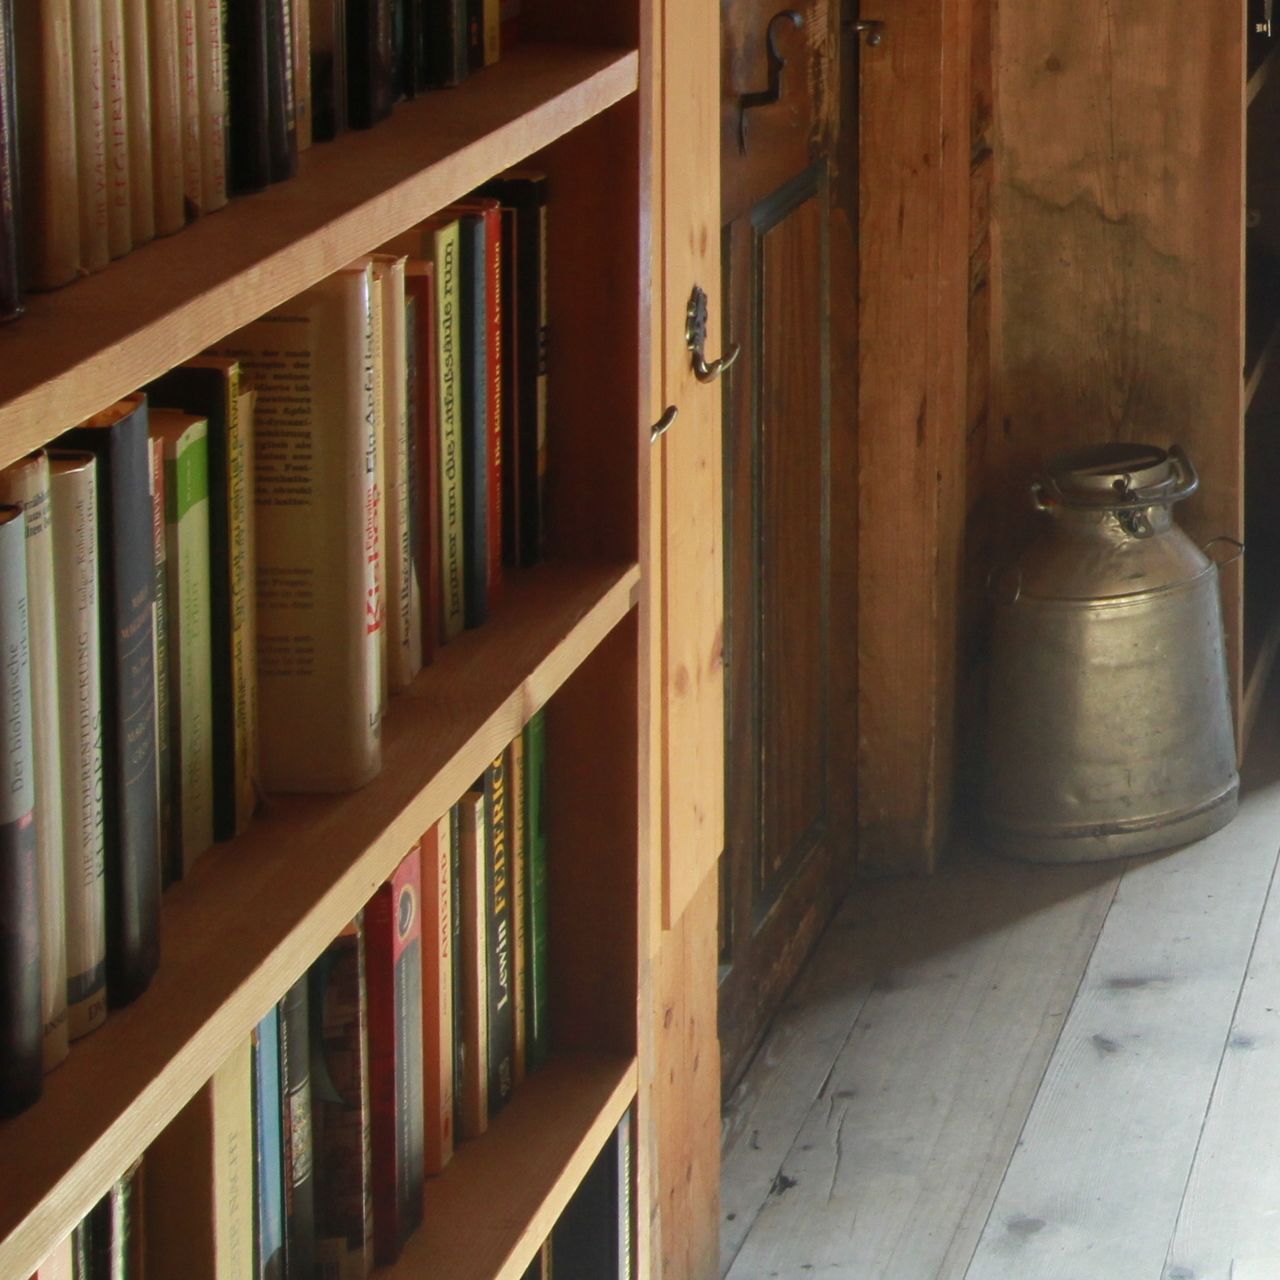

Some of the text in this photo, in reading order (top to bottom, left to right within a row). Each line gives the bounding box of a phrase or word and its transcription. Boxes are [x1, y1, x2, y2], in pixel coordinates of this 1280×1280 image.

[227, 381, 239, 452] schwer
[441, 239, 461, 618] Immer um die Litfaßsäule rum
[494, 435, 502, 466] Die
[231, 554, 242, 597] Gott
[6, 643, 25, 793] Der biologische
[77, 631, 94, 886] DIE WIEDERENTDECKUNG
[91, 709, 105, 880] EUROPAS
[440, 853, 449, 959] AMISTAD
[495, 918, 509, 1013] Lewin
